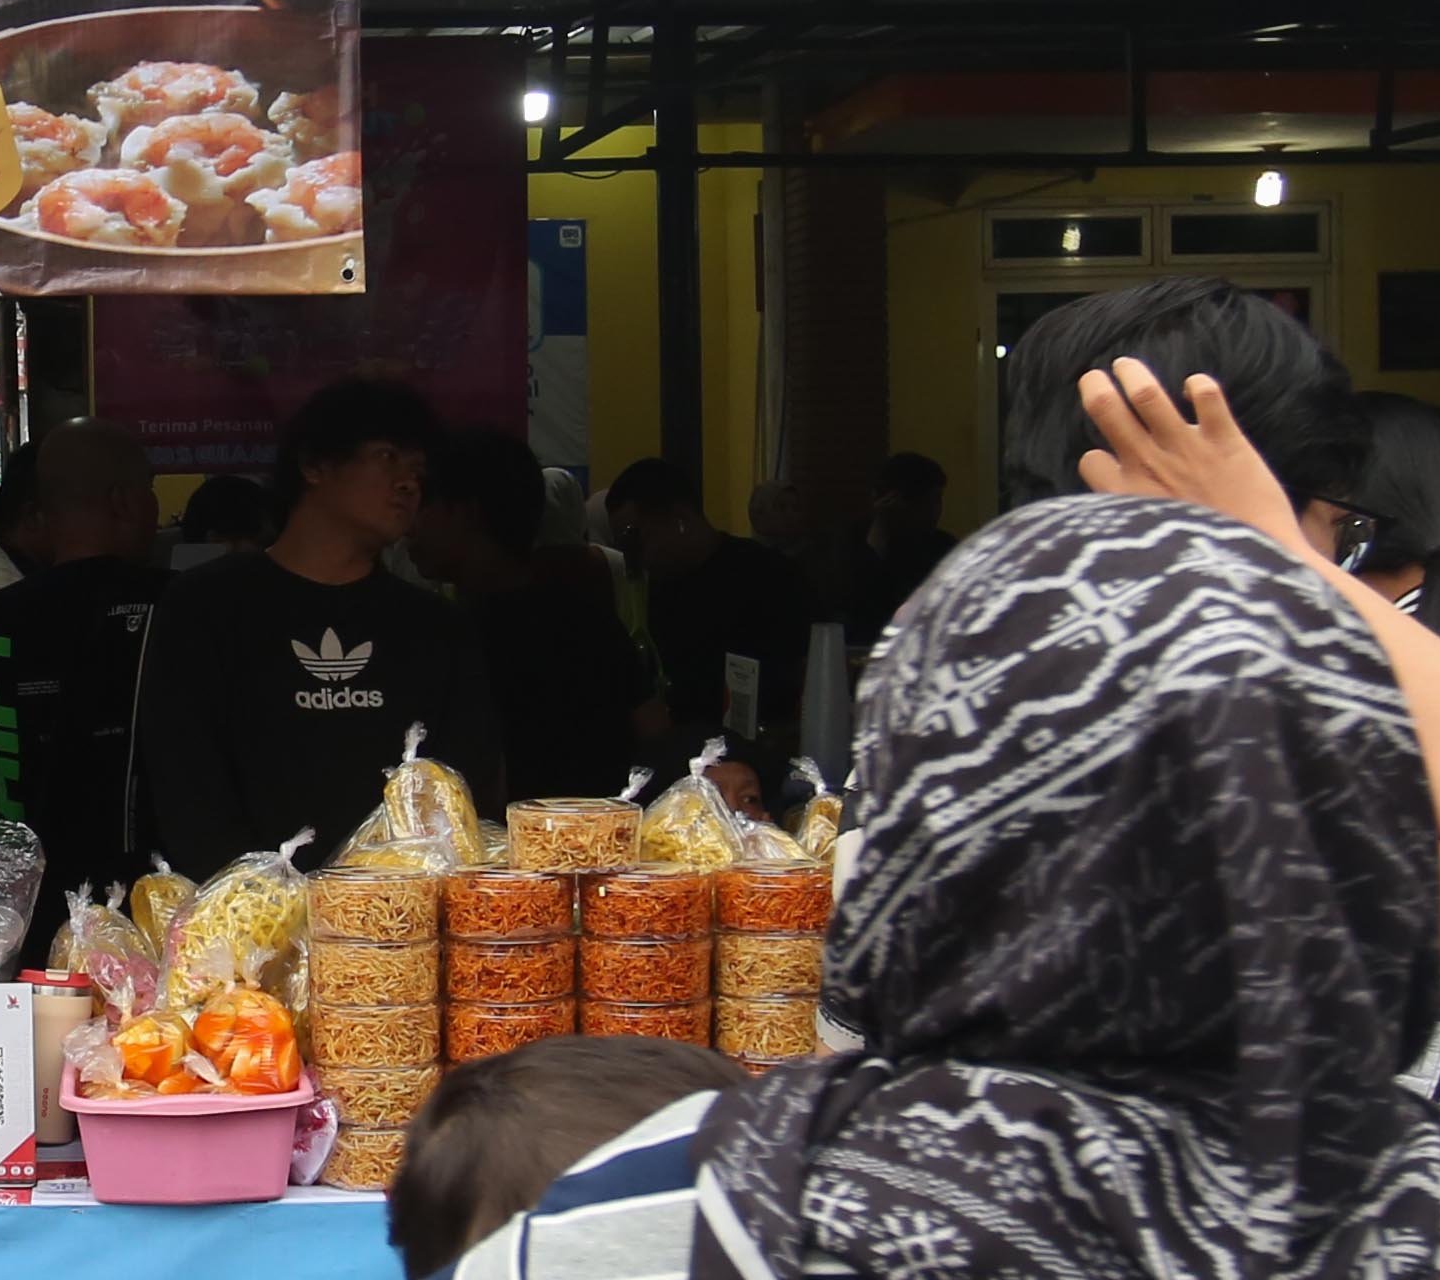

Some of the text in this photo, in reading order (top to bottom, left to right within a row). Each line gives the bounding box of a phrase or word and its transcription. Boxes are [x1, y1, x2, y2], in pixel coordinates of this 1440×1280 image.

[138, 419, 274, 434] Terima Pesanan
[294, 686, 385, 710] adidas
